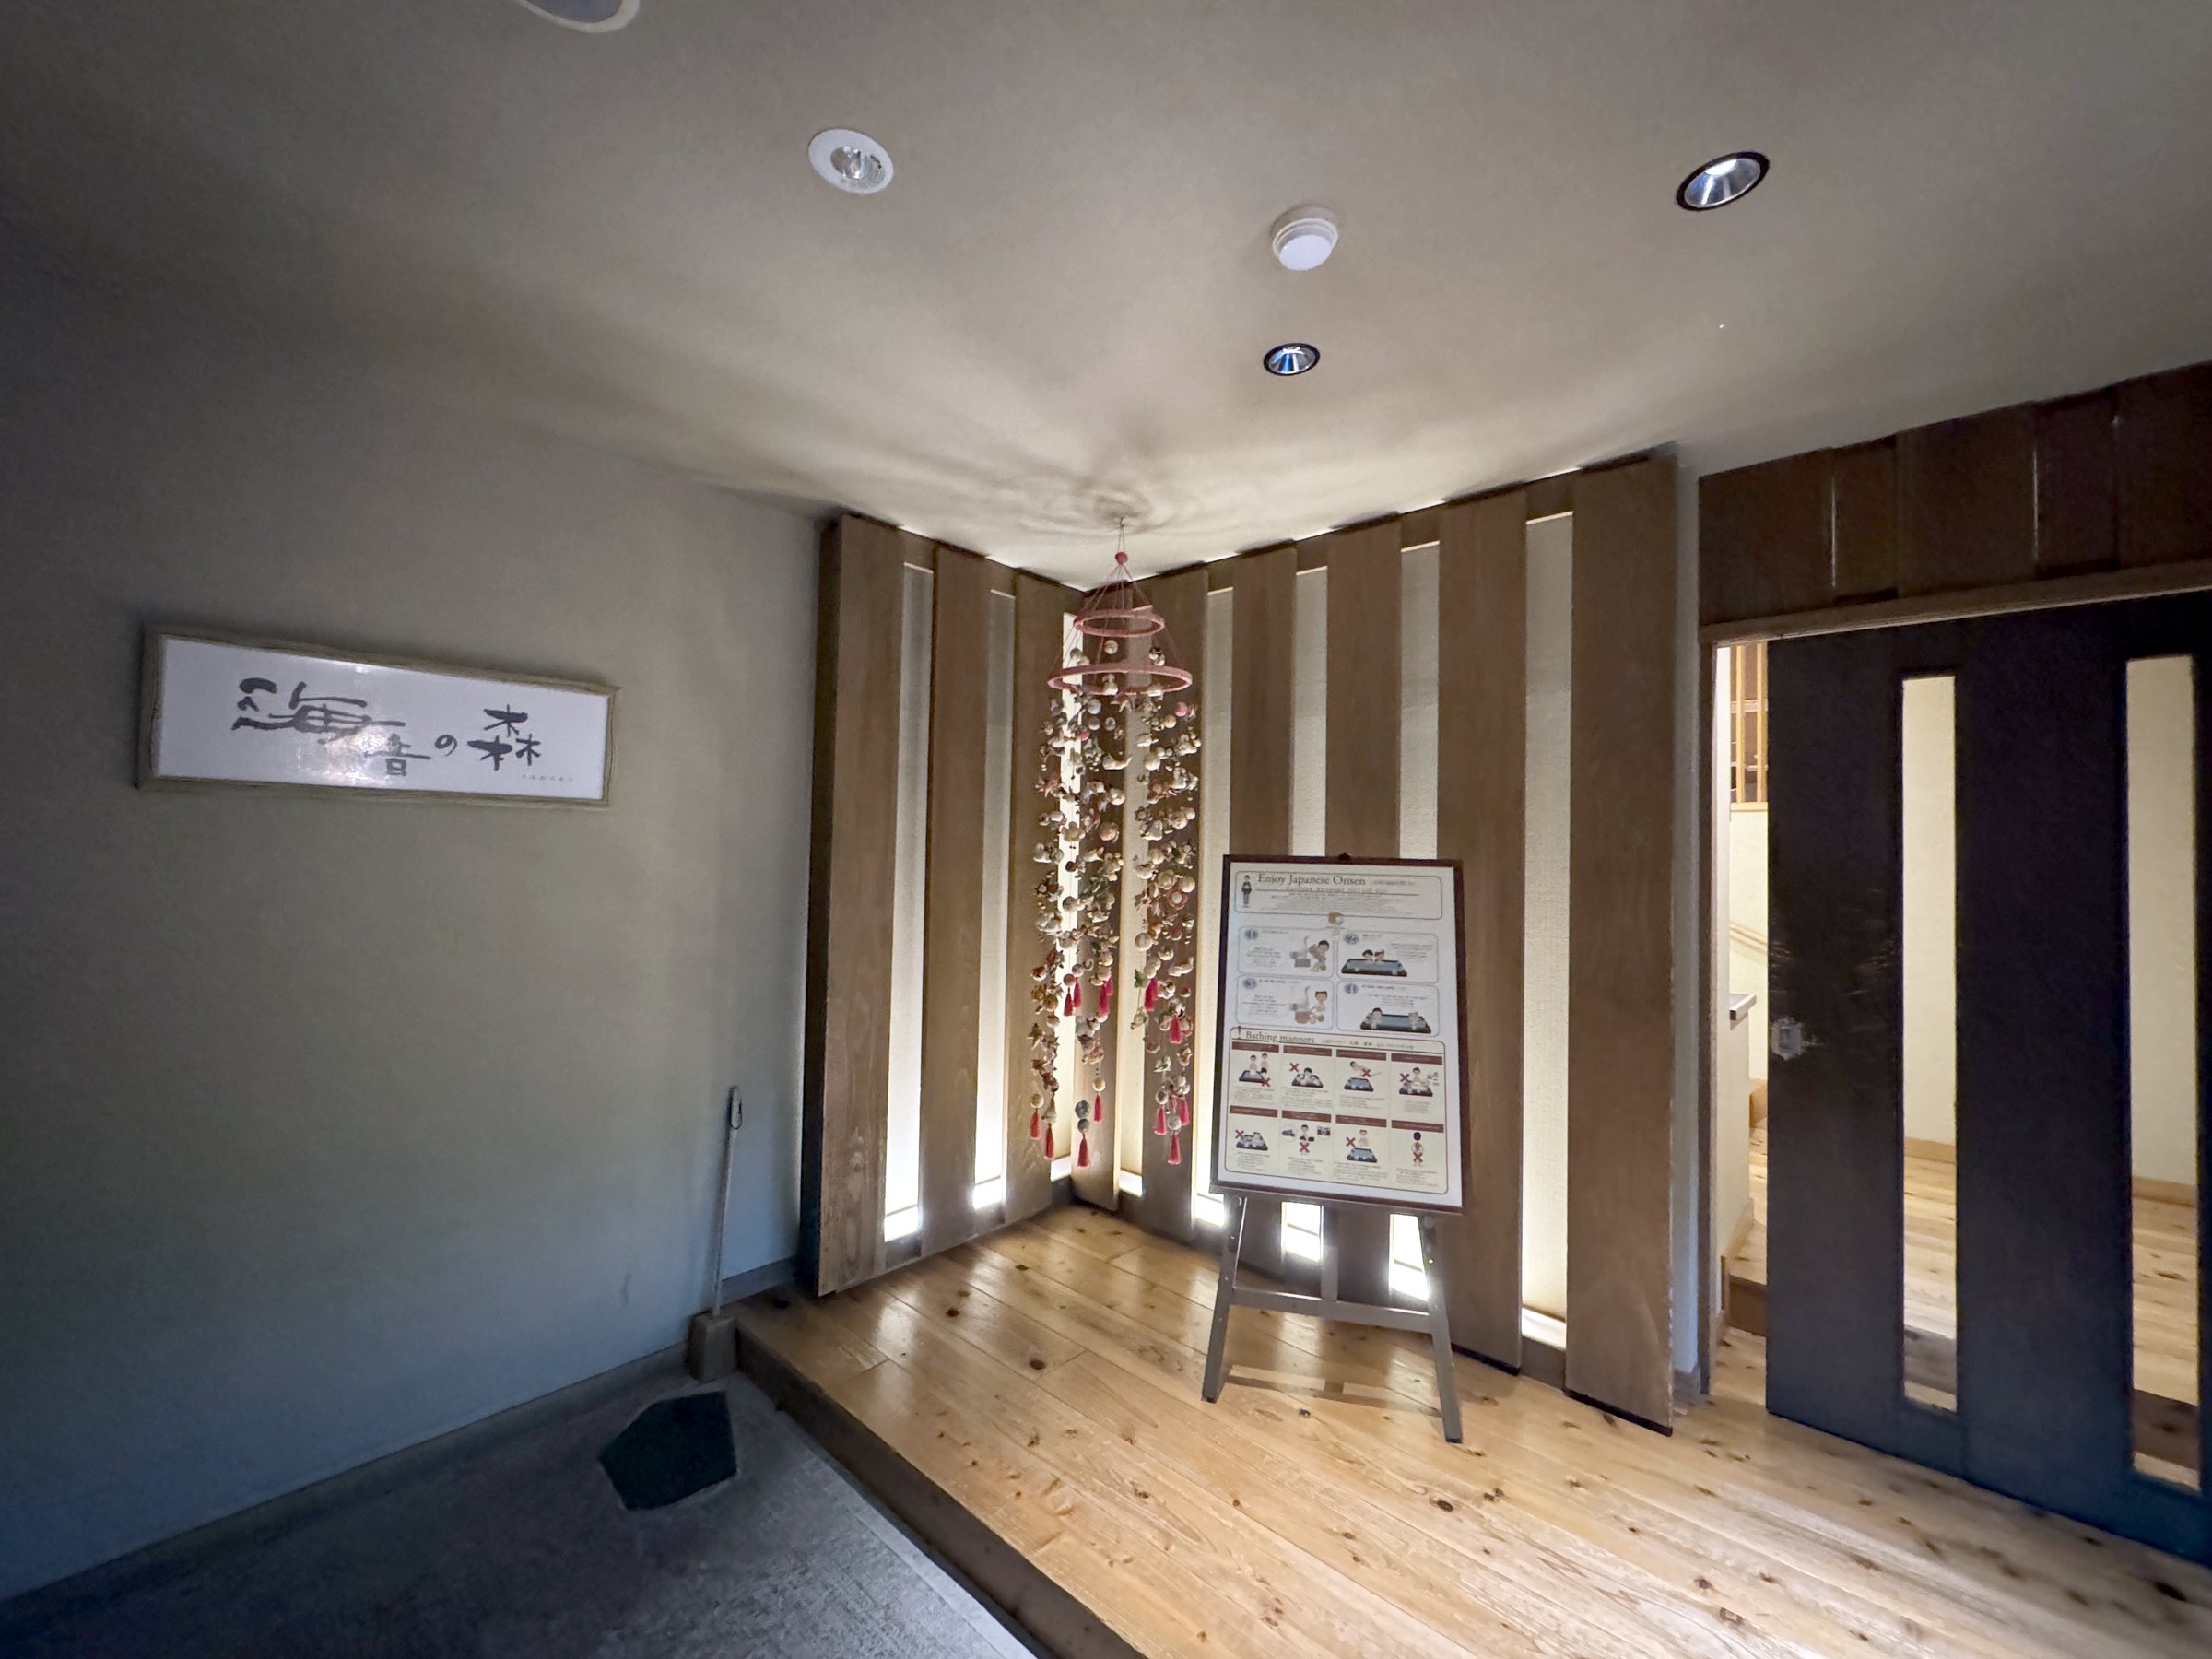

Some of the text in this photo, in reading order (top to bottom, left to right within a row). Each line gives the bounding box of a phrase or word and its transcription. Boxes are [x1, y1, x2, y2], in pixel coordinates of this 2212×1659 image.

[1258, 874, 1286, 885] Enjoy
[1289, 874, 1330, 886] Japanese
[1333, 875, 1366, 886] Onsen
[1245, 1030, 1278, 1044] Bathing
[1279, 1034, 1315, 1043] manners
